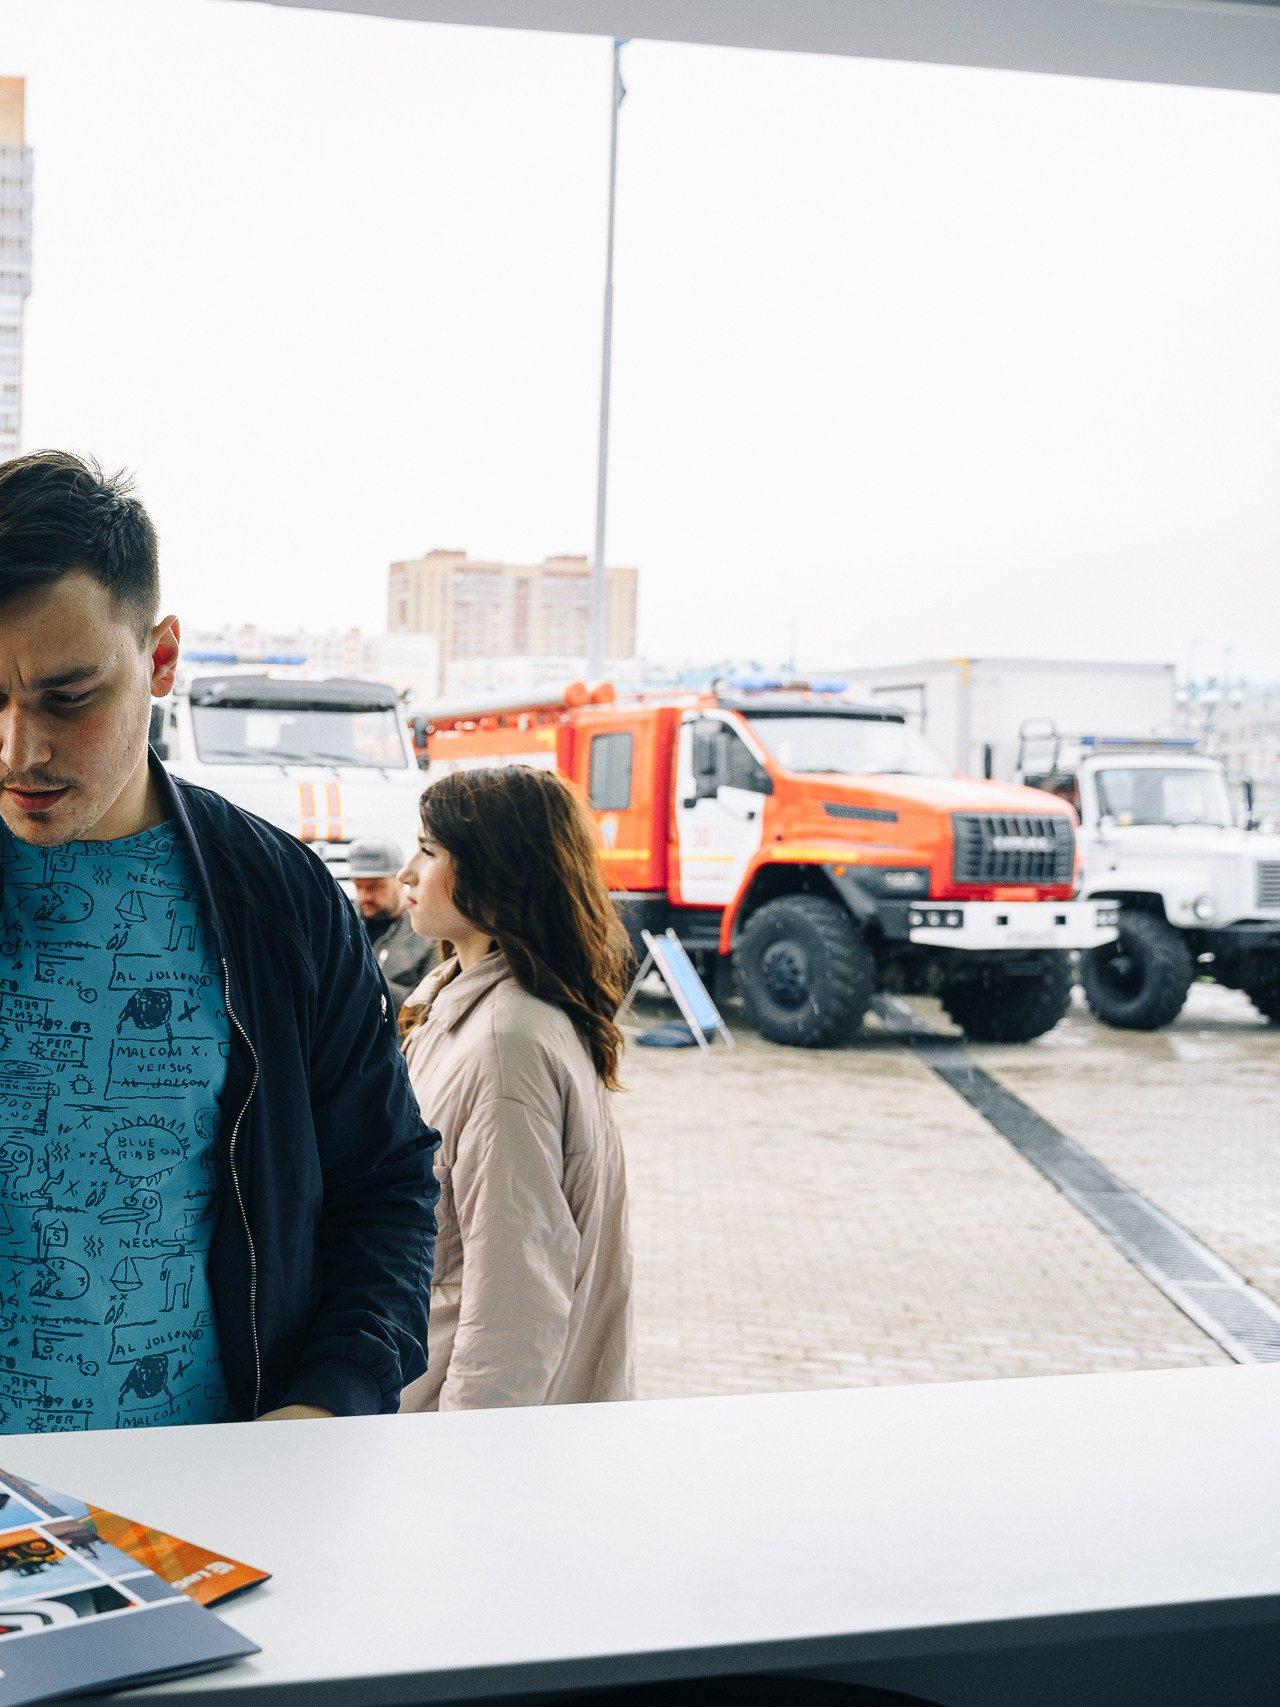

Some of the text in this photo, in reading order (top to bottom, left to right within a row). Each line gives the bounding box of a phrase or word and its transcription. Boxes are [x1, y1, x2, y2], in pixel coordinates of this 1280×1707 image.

[126, 871, 168, 887] NECK
[116, 971, 137, 983] AL
[46, 1038, 73, 1049] PER
[116, 1045, 182, 1058] MALCOM
[137, 1063, 193, 1074] VERSUS
[118, 1136, 156, 1148] BLUE
[118, 1238, 160, 1249] NECK
[115, 1343, 136, 1356] AL
[123, 1404, 181, 1428] MALCOM
